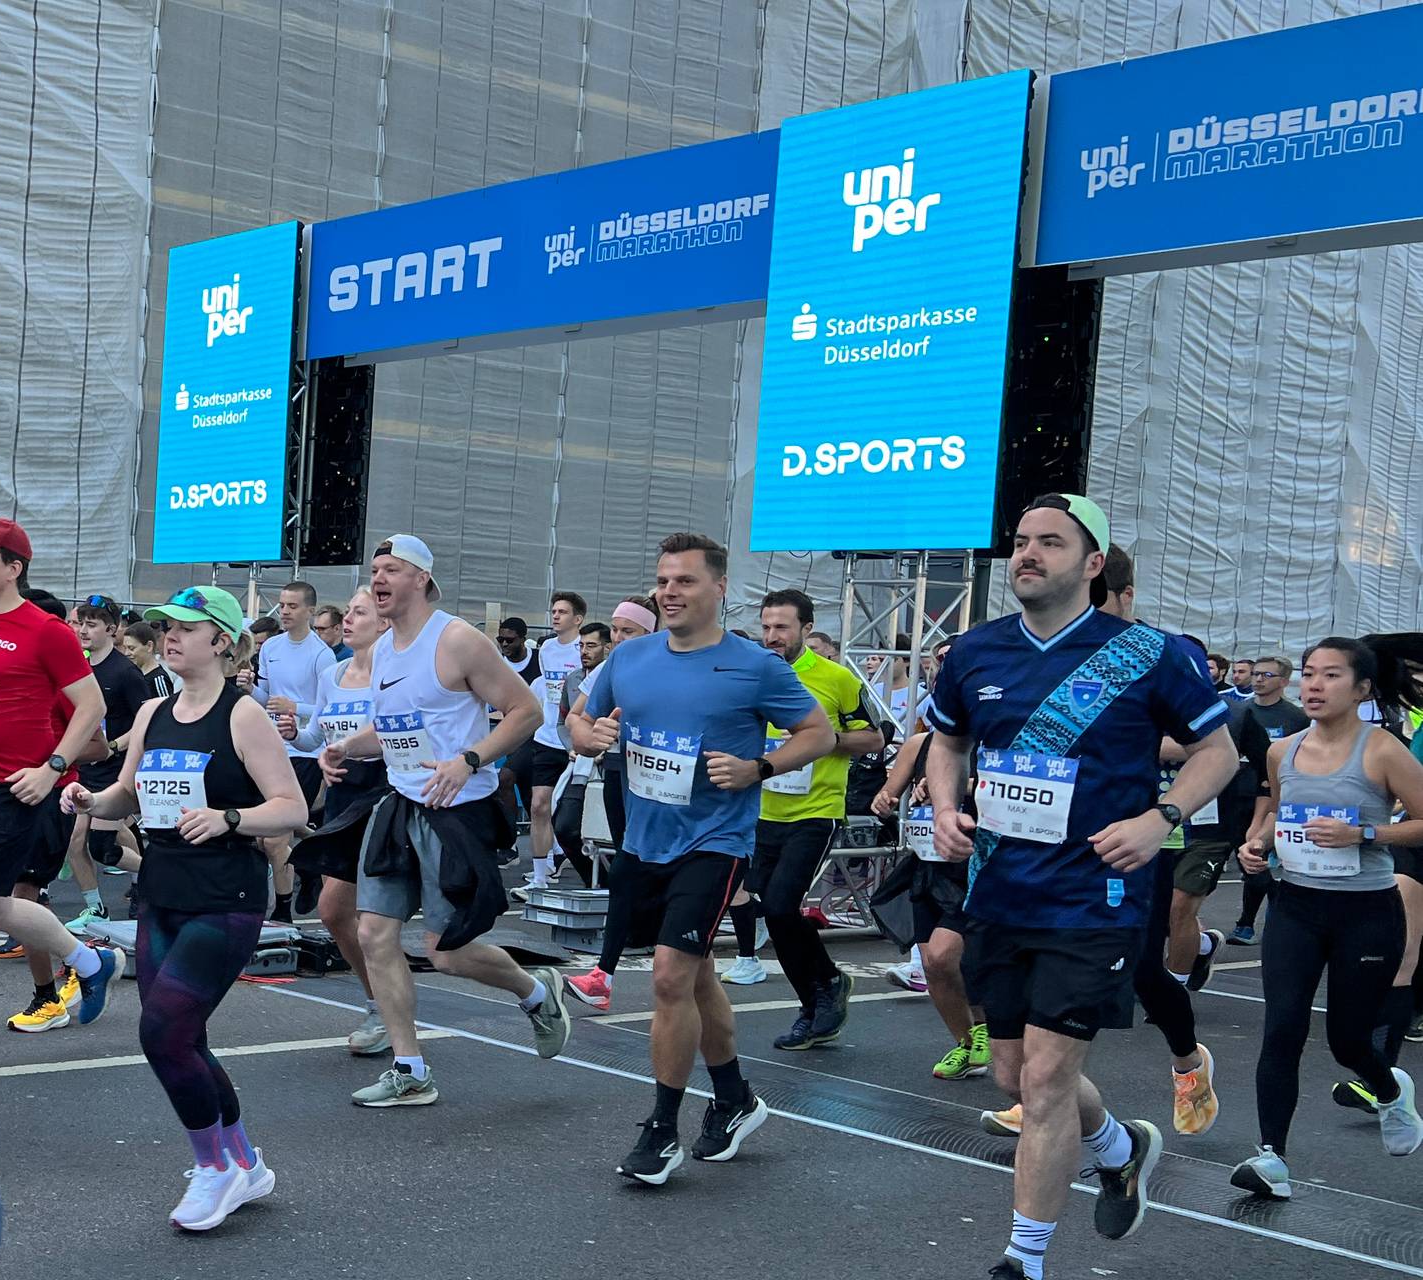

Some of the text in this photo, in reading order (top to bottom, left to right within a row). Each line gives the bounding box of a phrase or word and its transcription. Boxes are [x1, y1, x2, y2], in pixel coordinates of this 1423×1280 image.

[1168, 88, 1423, 154] DÜSSELDOR
[1080, 135, 1129, 172] uni
[1164, 120, 1403, 181] MARATHON
[843, 147, 915, 206] uni
[1087, 163, 1146, 199] per
[599, 193, 770, 241] DÜSSELDORF
[852, 192, 941, 252] per
[544, 225, 575, 253] uni
[596, 220, 743, 262] MARATHON
[328, 236, 503, 312] START
[547, 246, 585, 275] per
[201, 273, 241, 315] uni
[206, 306, 253, 347] per
[824, 304, 978, 338] Stadtsparkasse
[824, 336, 930, 365] Düsseldorf
[192, 386, 272, 410] Stadtsparkasse
[192, 408, 248, 429] Düsseldorf
[782, 435, 966, 477] D.SPORTS
[169, 479, 267, 510] D.SPORTS
[383, 737, 419, 750] 11585
[650, 731, 666, 740] uni
[677, 736, 692, 745] uni
[651, 738, 669, 747] per
[677, 744, 695, 753] per
[160, 751, 175, 761] uni
[185, 752, 201, 762] uni
[160, 760, 177, 769] per
[184, 760, 203, 770] per
[632, 751, 681, 775] 11584
[985, 759, 1071, 778] per per per
[1013, 754, 1031, 764] uni
[1046, 759, 1065, 769] uni
[142, 780, 190, 795] 12125
[989, 780, 1053, 806] 11050
[1007, 804, 1027, 814] MAX
[1283, 830, 1314, 843] 15
